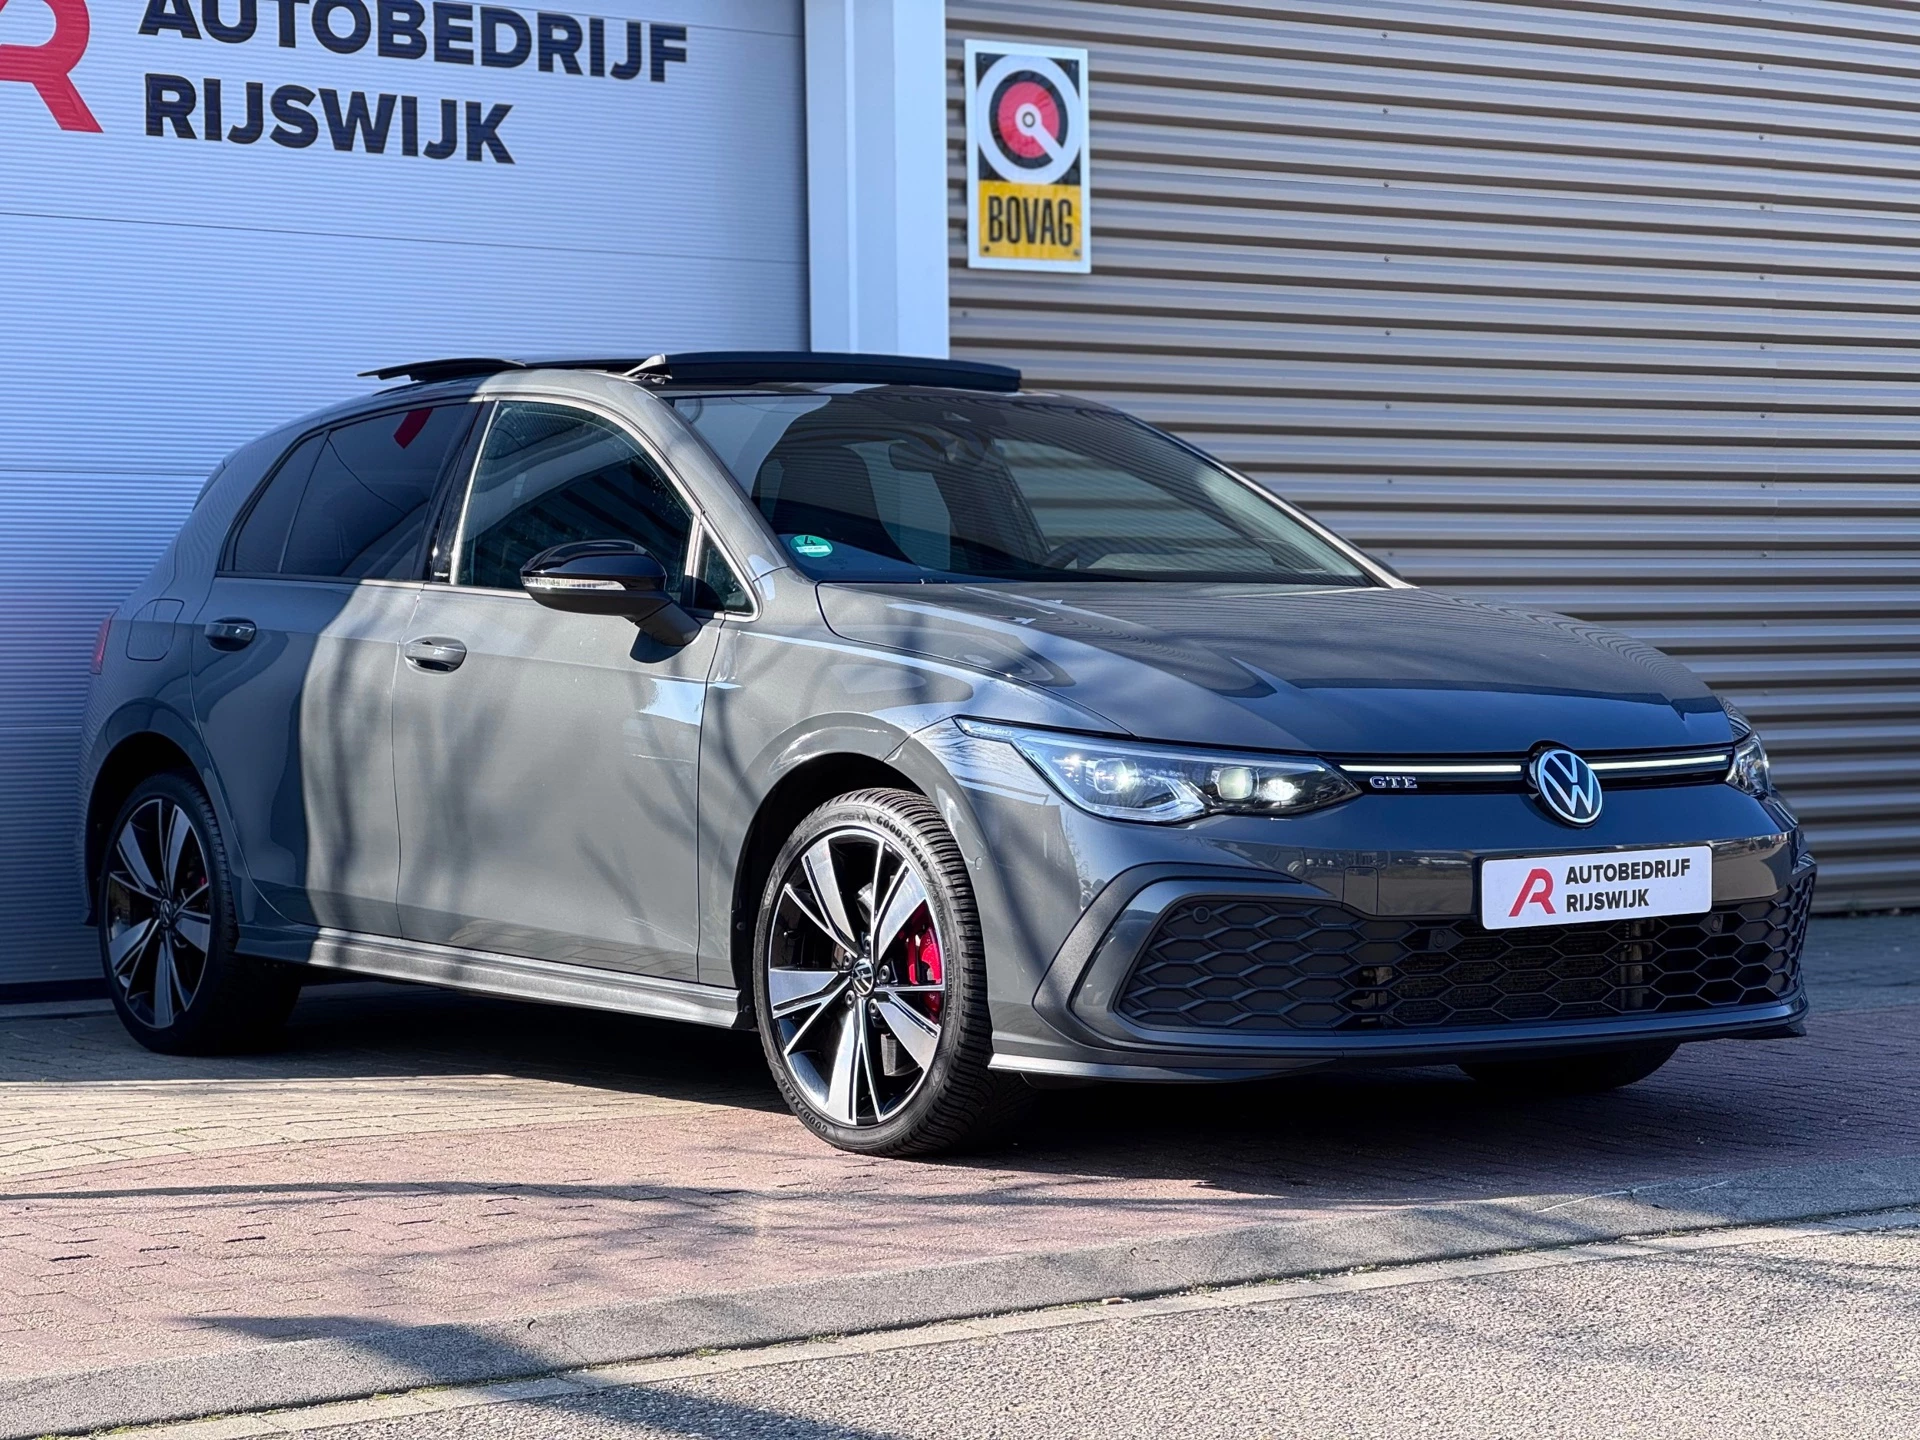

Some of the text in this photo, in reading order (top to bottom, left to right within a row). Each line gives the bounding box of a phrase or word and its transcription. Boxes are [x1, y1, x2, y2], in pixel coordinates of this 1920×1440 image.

[138, 0, 688, 83] AUTOBEDRIJF
[144, 73, 516, 165] RIJSWIJK
[987, 195, 1073, 247] BOVAG
[1369, 775, 1418, 789] GTE
[1565, 858, 1691, 885] AUTOBEDRIJF
[1566, 888, 1650, 913] RIJSWIJK
